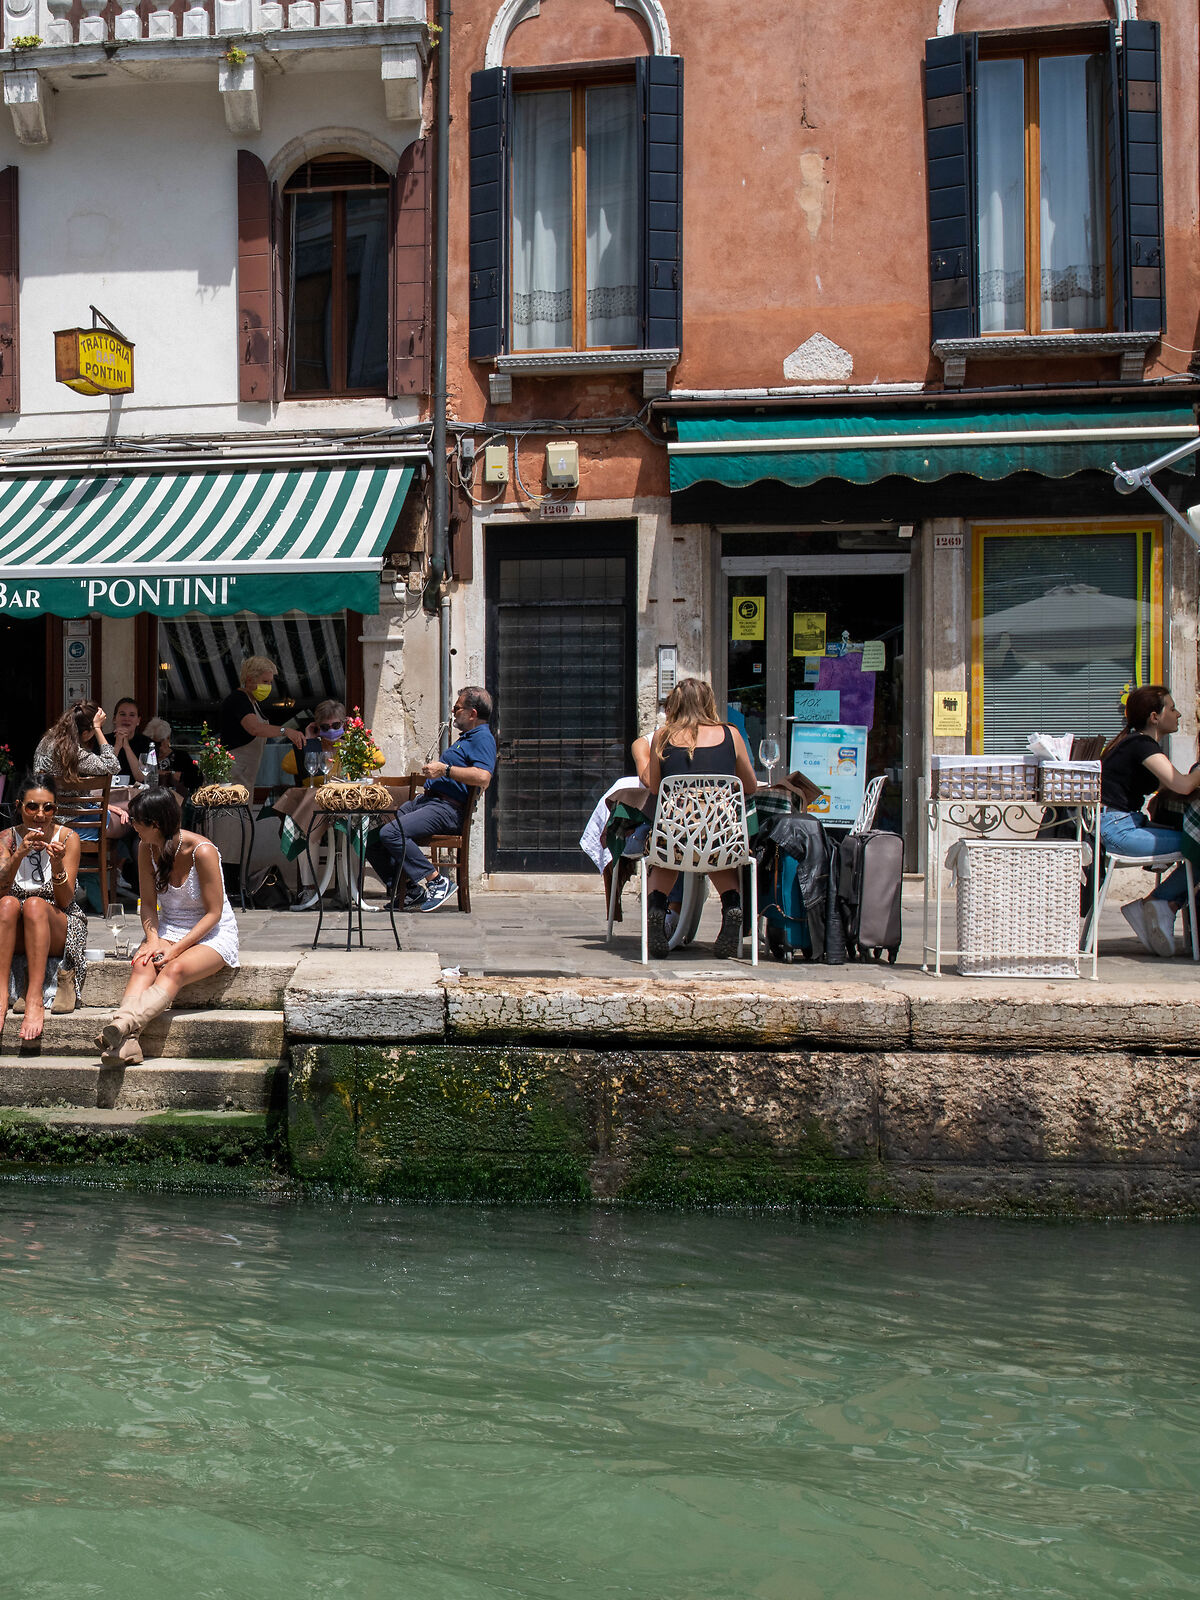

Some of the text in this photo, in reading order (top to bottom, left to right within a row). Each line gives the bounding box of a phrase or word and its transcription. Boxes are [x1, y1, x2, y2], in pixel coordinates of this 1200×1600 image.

[81, 335, 130, 364] TRATTORIA
[96, 350, 116, 367] BAR
[85, 362, 127, 383] PONTINI
[543, 504, 569, 515] 1269
[936, 537, 962, 546] 1269
[80, 576, 237, 608] "PONTINI"
